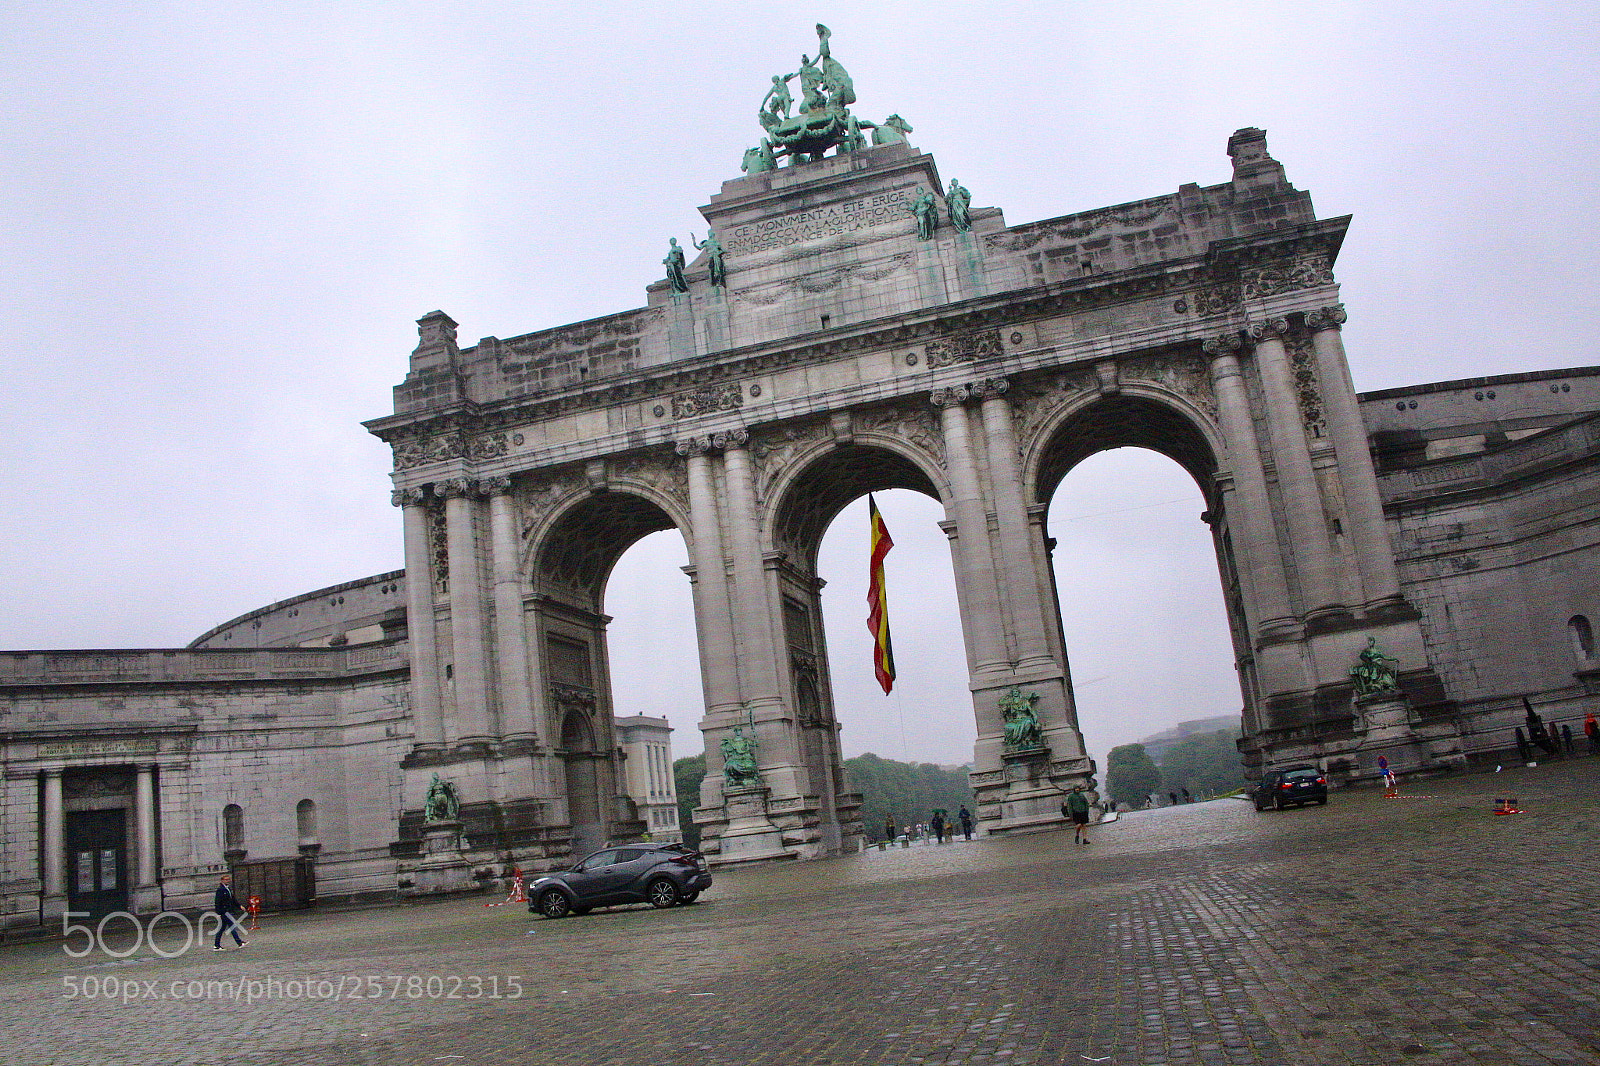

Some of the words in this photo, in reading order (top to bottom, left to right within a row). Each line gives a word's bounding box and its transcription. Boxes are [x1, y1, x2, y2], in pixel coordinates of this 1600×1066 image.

[734, 226, 749, 238] CE
[828, 208, 836, 217] A
[803, 224, 811, 233] A
[816, 219, 830, 229] LA
[829, 227, 844, 236] DE
[849, 222, 863, 232] LA
